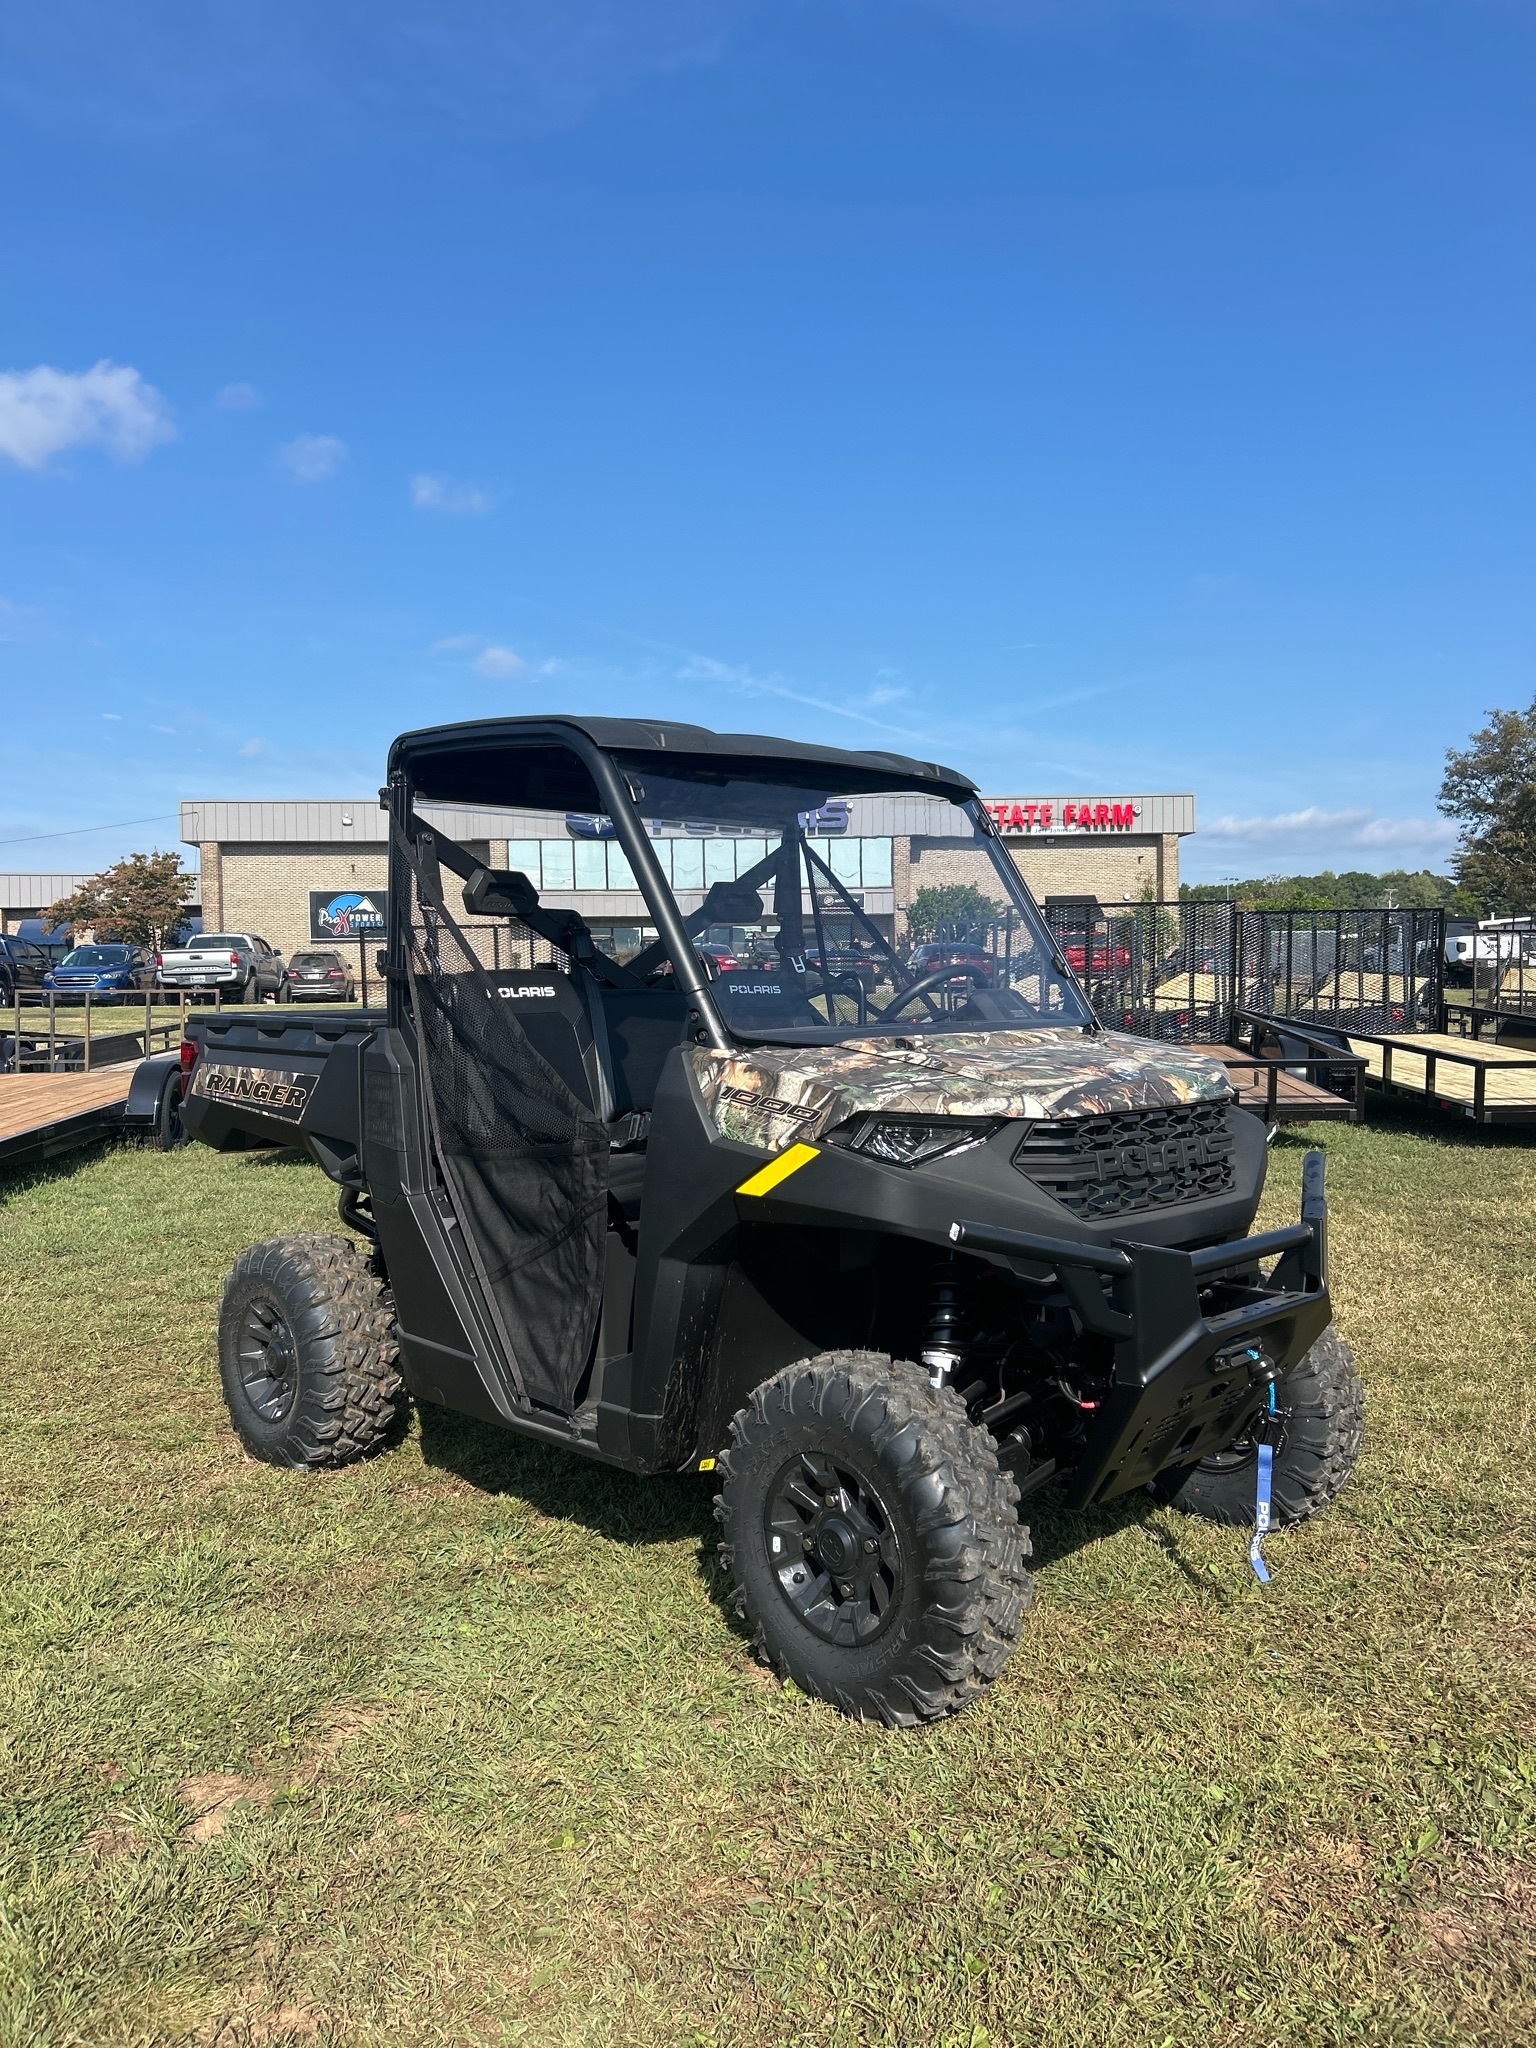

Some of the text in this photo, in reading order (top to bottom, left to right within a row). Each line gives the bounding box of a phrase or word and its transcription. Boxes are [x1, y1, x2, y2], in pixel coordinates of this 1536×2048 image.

[1064, 804, 1134, 826] FARM
[349, 913, 381, 922] POWER
[486, 986, 556, 999] OLARIS
[729, 984, 782, 995] POLARIS
[206, 1073, 307, 1108] RANGER
[720, 1086, 823, 1123] 1000
[1095, 1132, 1236, 1182] POLARIS
[1250, 1501, 1269, 1562] POLARIS
